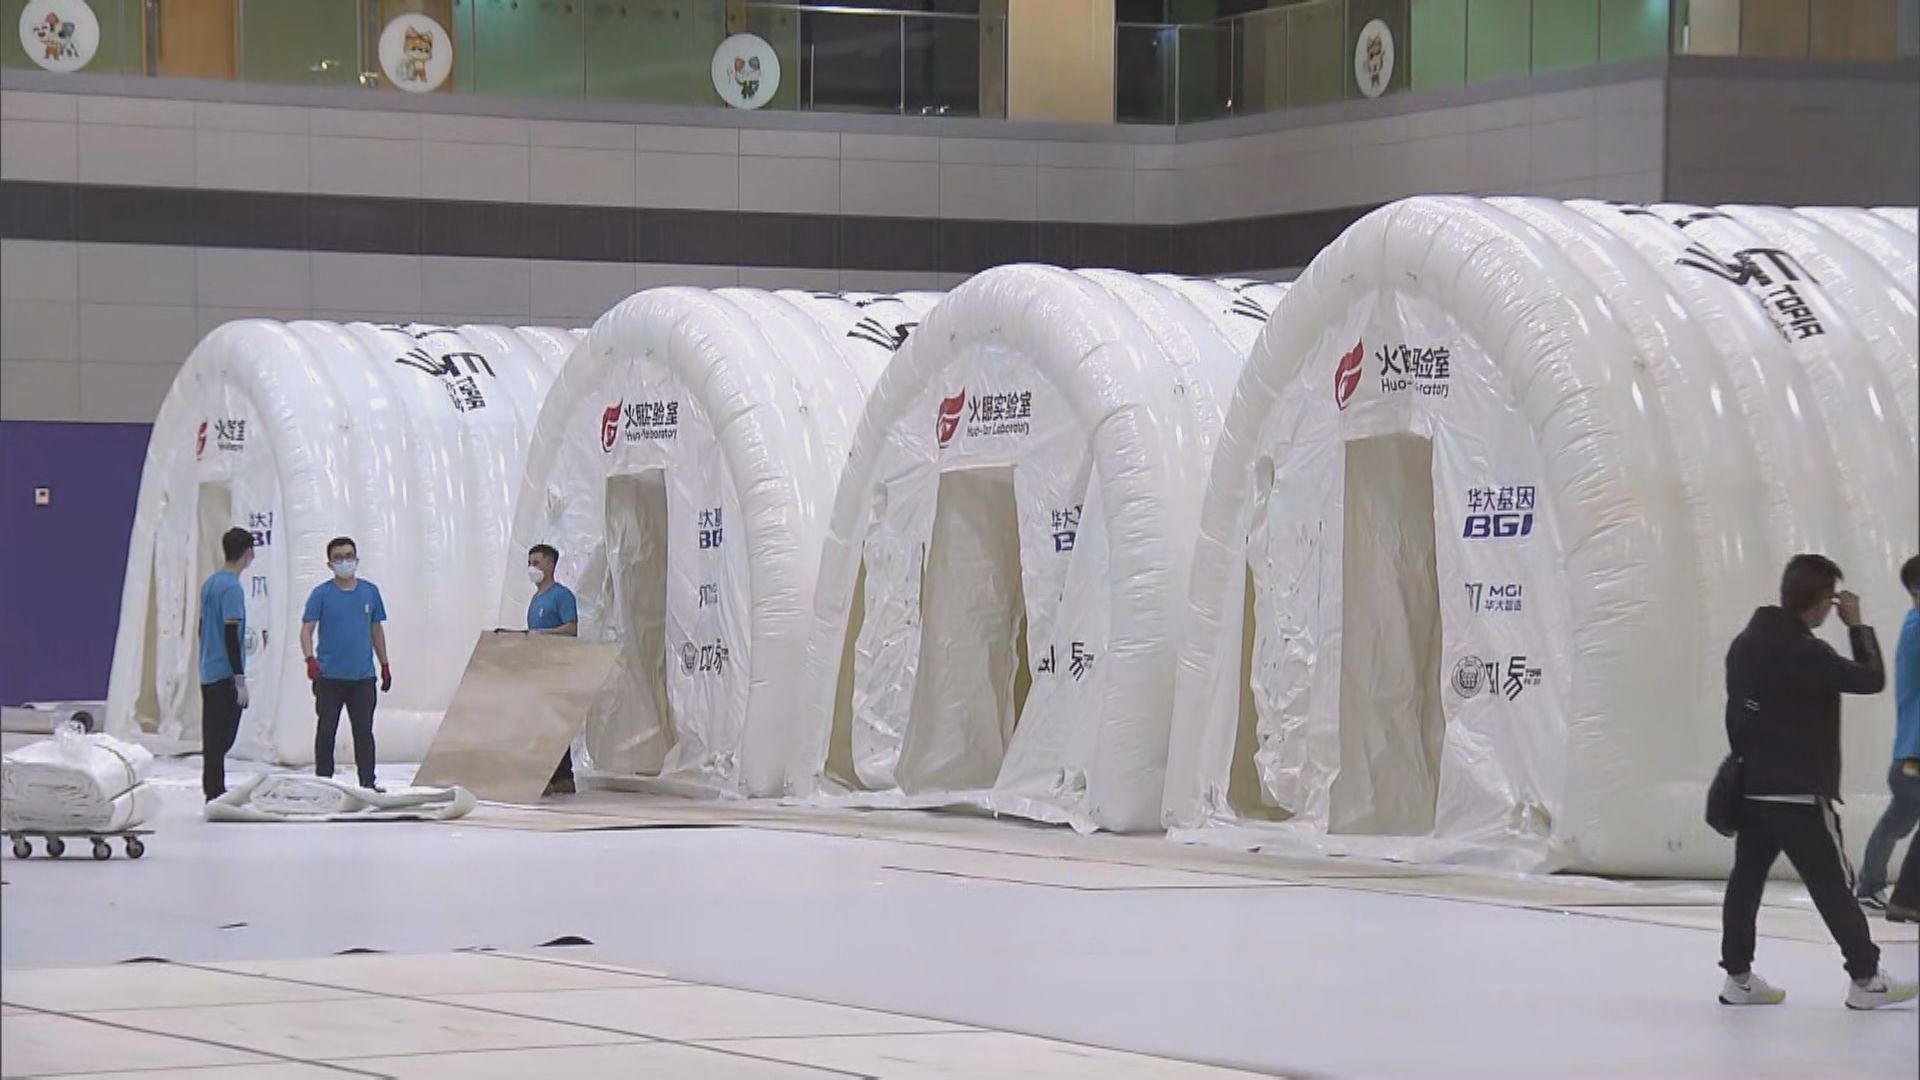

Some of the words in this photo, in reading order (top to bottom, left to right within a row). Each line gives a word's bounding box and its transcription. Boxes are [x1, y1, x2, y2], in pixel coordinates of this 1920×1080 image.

[1467, 485, 1535, 513] 华大基因
[1462, 513, 1534, 539] BGI
[1489, 583, 1522, 598] MGI
